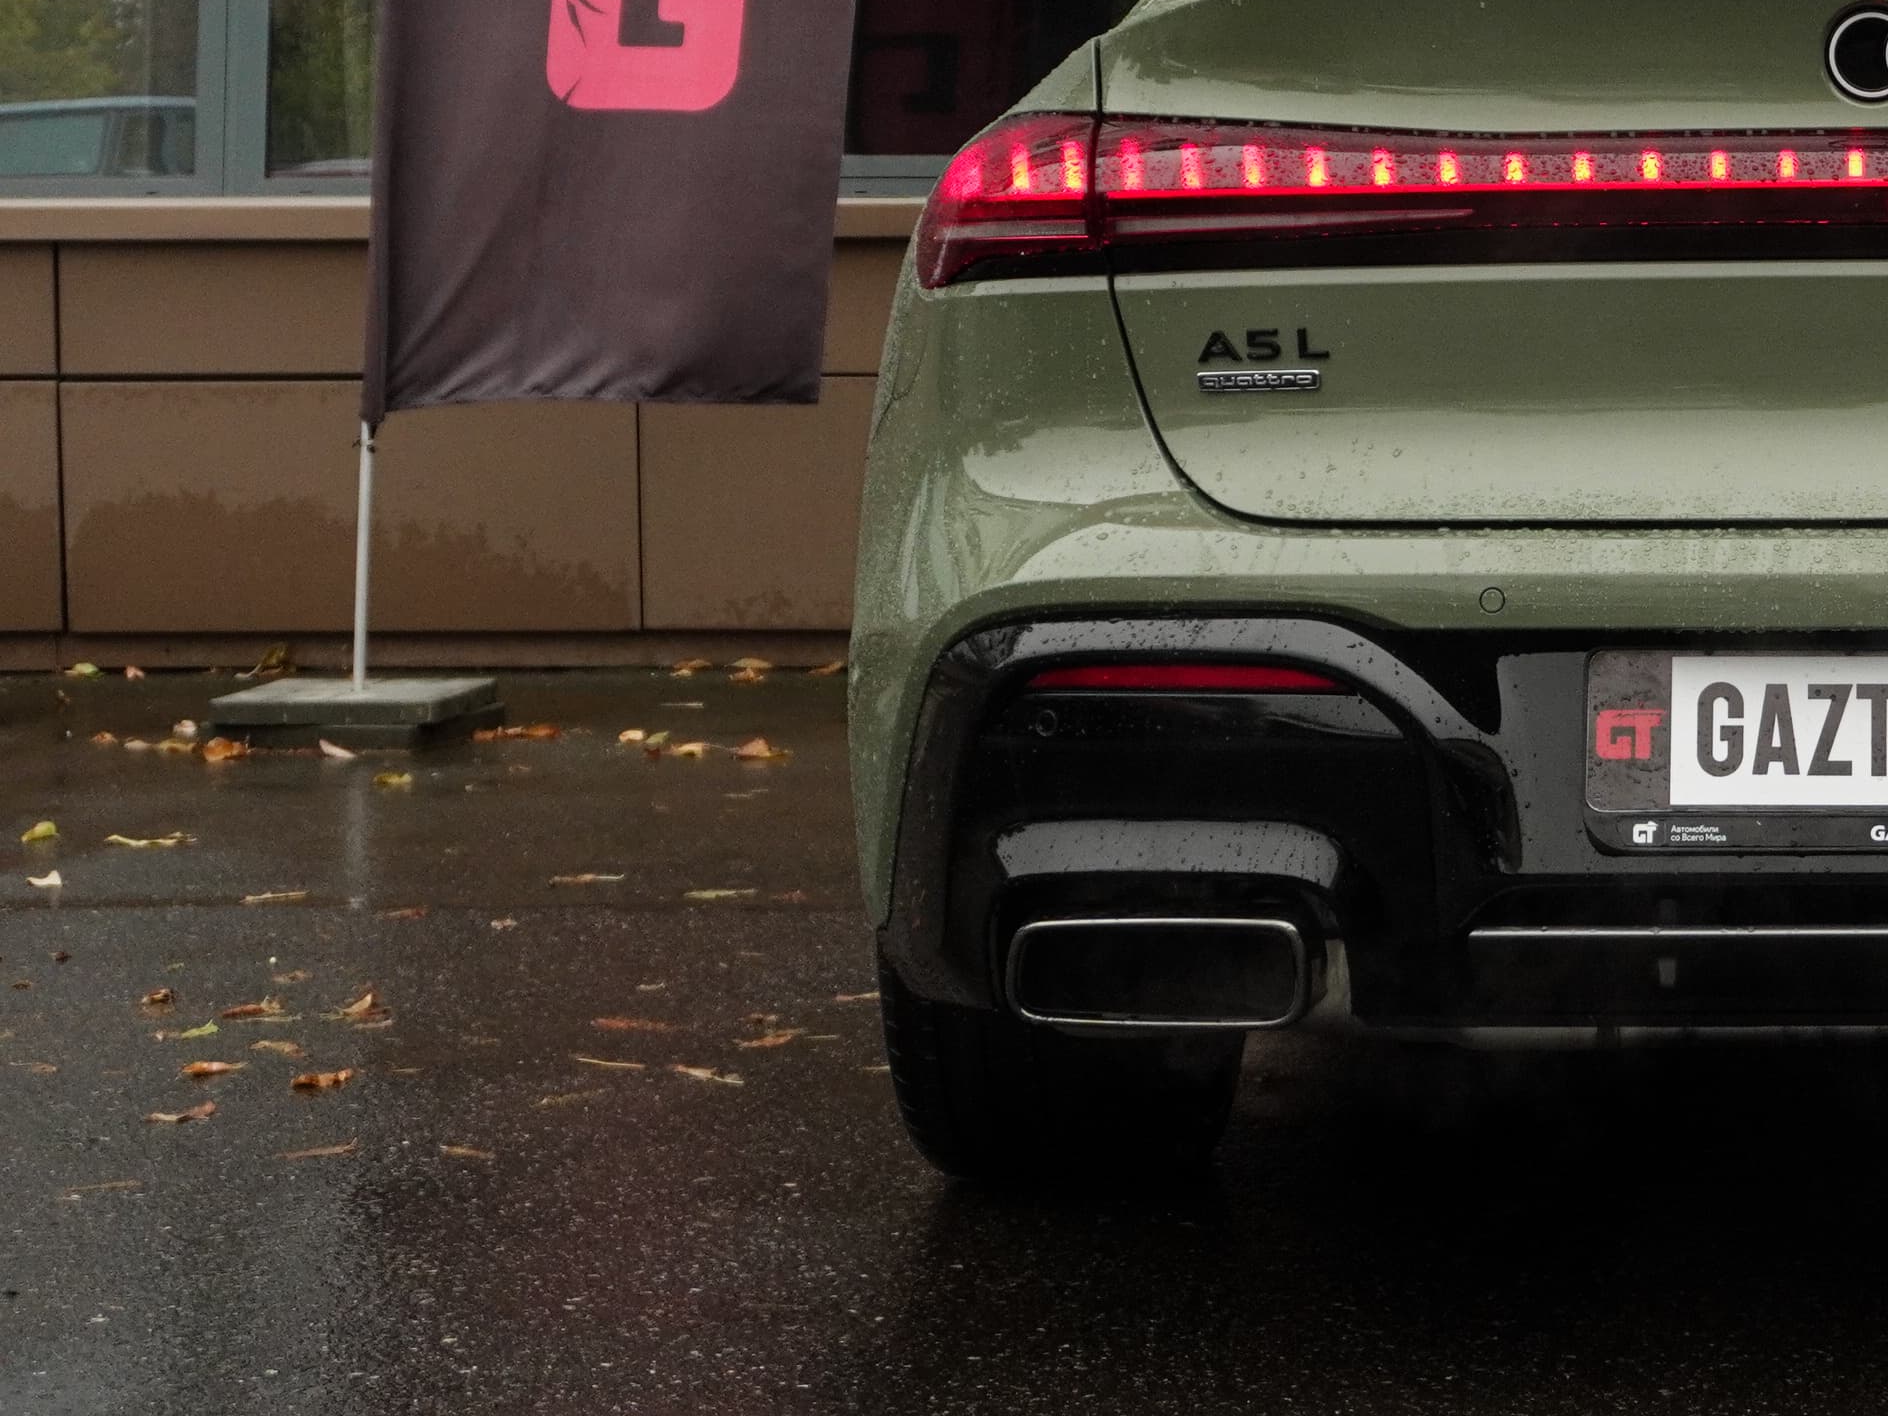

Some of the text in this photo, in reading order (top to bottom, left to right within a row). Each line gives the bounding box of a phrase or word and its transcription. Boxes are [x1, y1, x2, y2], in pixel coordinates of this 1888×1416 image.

[1201, 372, 1314, 389] quattro
[1595, 709, 1665, 761] GT
[1632, 821, 1659, 844] GT
[1670, 824, 1720, 834] Автомобили
[1682, 833, 1705, 842] Всего
[1705, 833, 1728, 843] Мира
